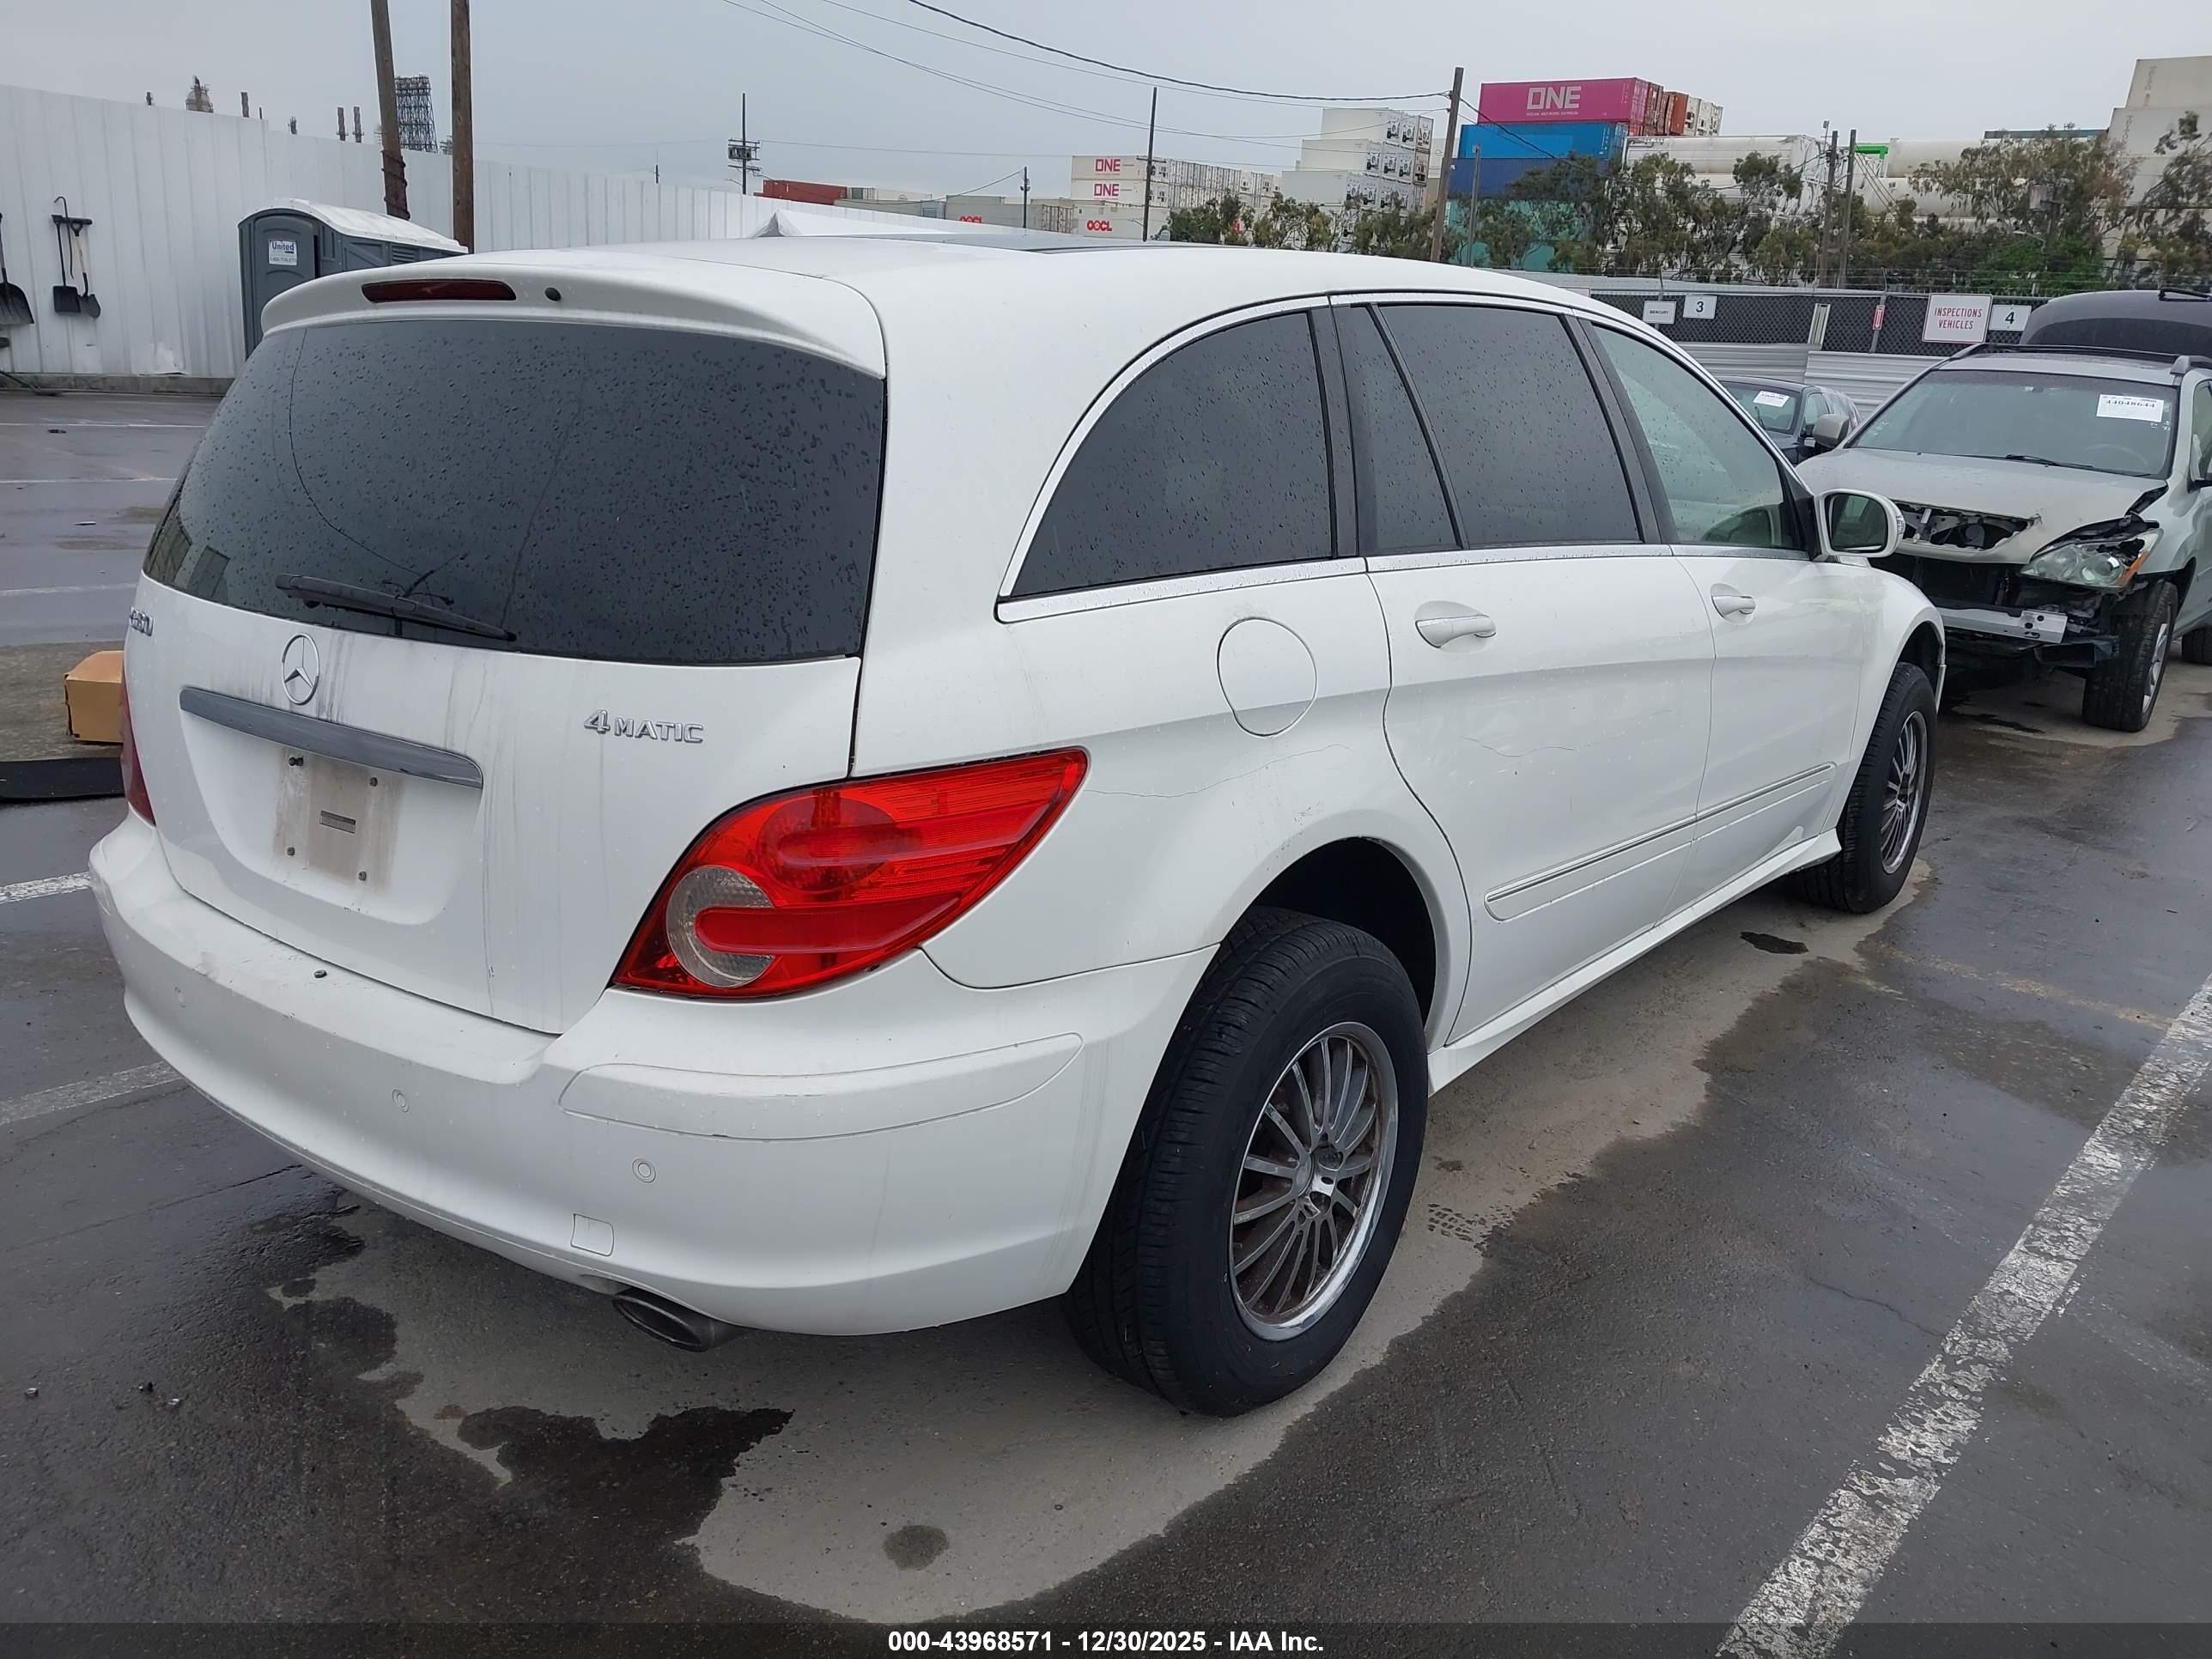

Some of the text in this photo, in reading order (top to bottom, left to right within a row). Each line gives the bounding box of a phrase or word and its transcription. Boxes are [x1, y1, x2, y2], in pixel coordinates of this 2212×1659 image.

[1527, 86, 1582, 110] ONE
[1095, 158, 1121, 172] ONE
[1093, 183, 1120, 197] ONE
[1086, 219, 1113, 232] OOCL
[272, 241, 295, 251] United
[1695, 301, 1705, 313] 3
[1934, 307, 1983, 319] INSPECTIONS
[1937, 319, 1974, 330] VEHICLES
[2004, 311, 2015, 325] 4
[584, 709, 703, 743] 4MATIC
